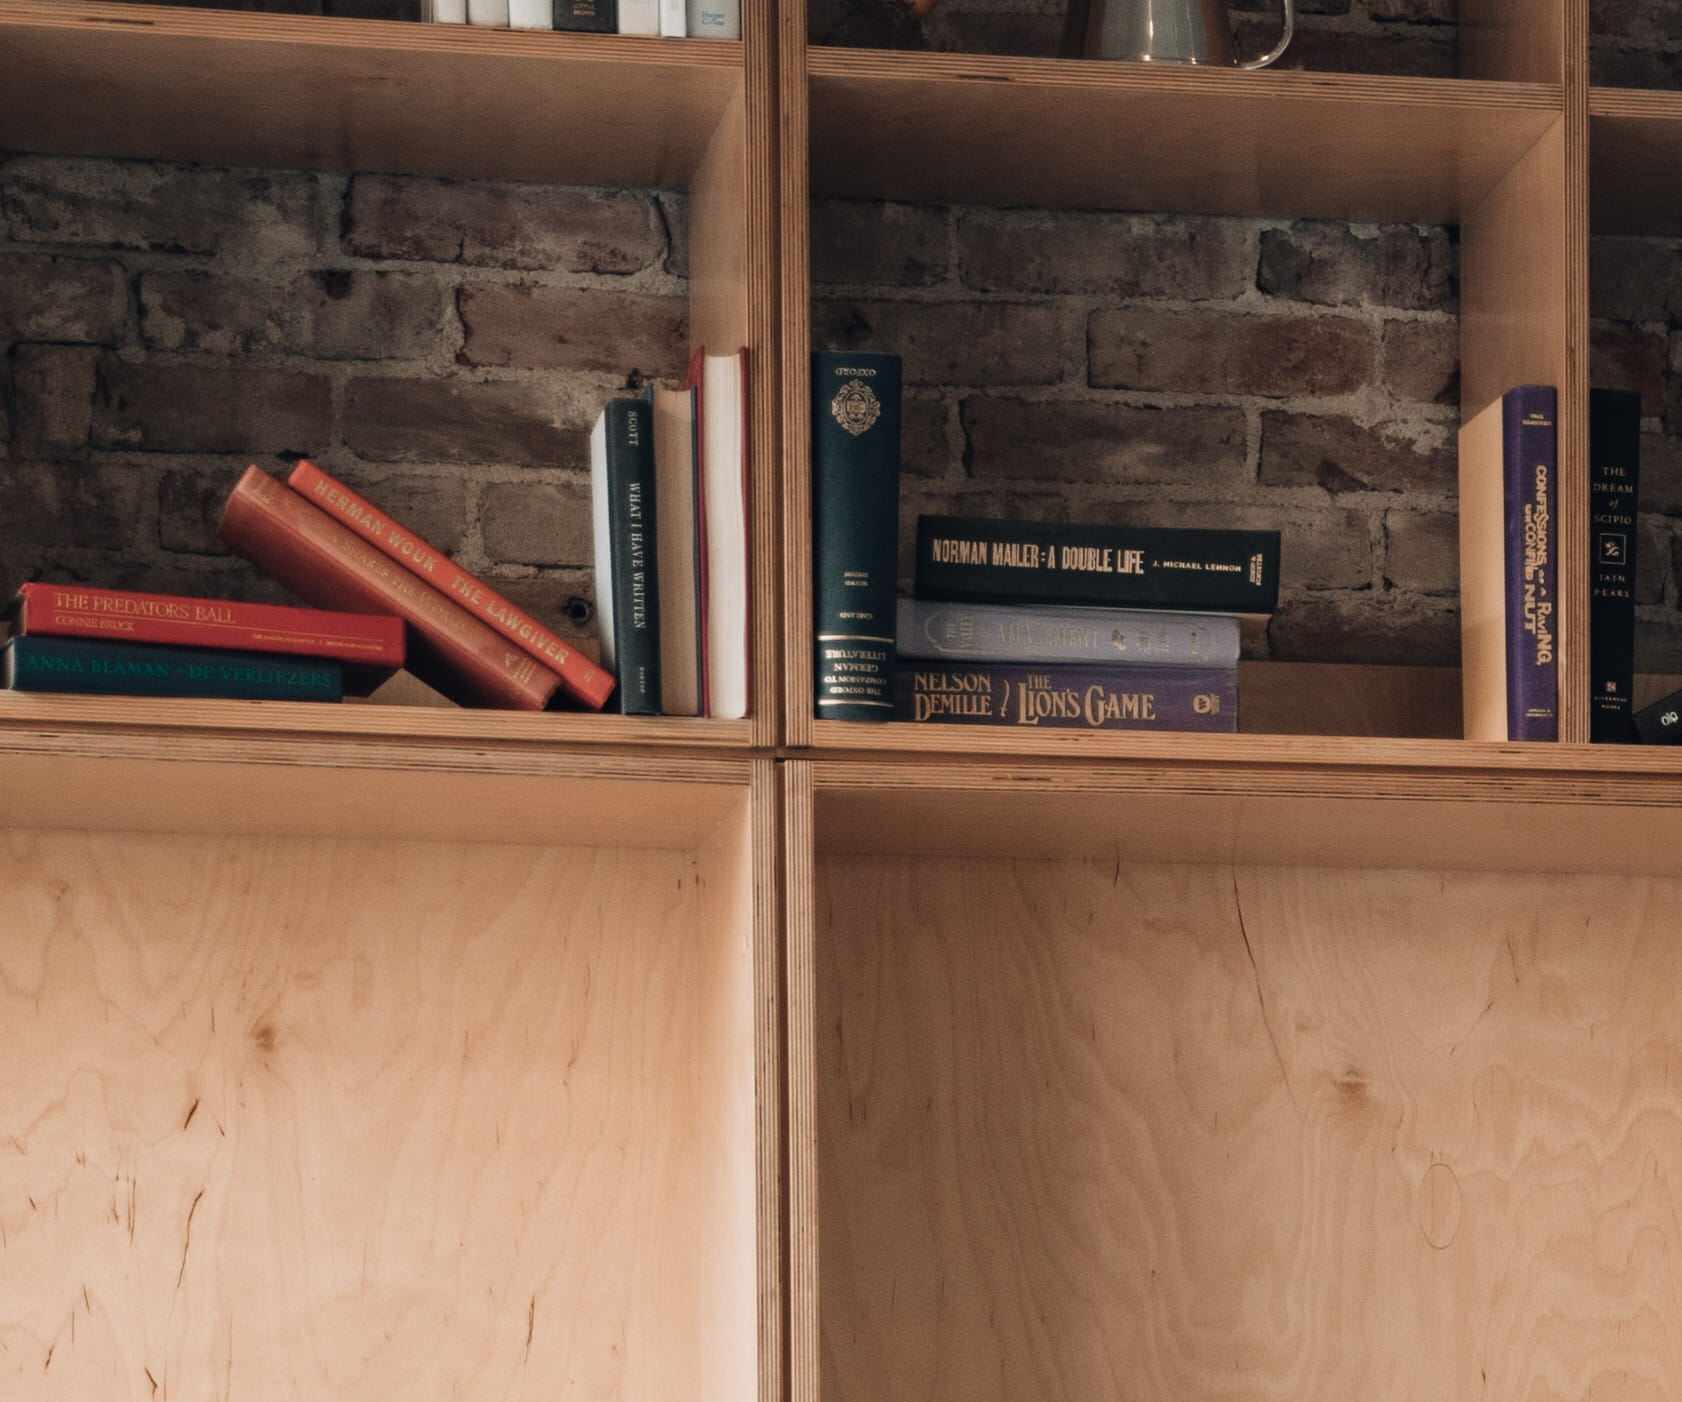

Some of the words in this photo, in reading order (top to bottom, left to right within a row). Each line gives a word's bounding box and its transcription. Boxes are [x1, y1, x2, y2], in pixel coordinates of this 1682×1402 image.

[835, 367, 877, 376] OXFORD
[628, 410, 639, 446] SCOTT
[1603, 467, 1625, 477] THE
[1593, 483, 1633, 493] DREAM
[629, 482, 642, 520] WHAT
[1609, 499, 1619, 509] of
[1534, 465, 1549, 565] CONFESSIONS
[1594, 514, 1632, 525] SCIPIO
[631, 532, 643, 568] HAVE
[932, 538, 987, 565] NORMAN
[1047, 545, 1057, 569] A
[1062, 546, 1113, 573] DOUBLE
[1117, 549, 1145, 574] LIFE
[313, 479, 385, 534] HERMAN
[387, 531, 437, 571] WOUK
[451, 576, 483, 606] THE
[486, 602, 568, 665] LAWGIVER
[1152, 560, 1161, 568] J.
[1163, 561, 1202, 570] MICHAEL
[1205, 564, 1242, 572] LENNON
[1600, 574, 1625, 582] IAIN
[633, 571, 647, 630] WRITTEN
[1594, 588, 1630, 598] PEARS
[53, 592, 90, 609] THE
[93, 595, 191, 620] PREDATORS
[195, 606, 237, 625] BALL
[1524, 584, 1536, 635] NUT
[55, 615, 99, 629] CONNIE
[99, 617, 136, 632] BRUCK
[825, 649, 886, 661] LITERATURE
[26, 655, 84, 673] ANNA
[90, 659, 169, 678] BLAMAN
[188, 664, 214, 680] DE
[218, 666, 331, 688] VERLIEZERS
[834, 662, 879, 672] GERMAN
[824, 675, 837, 683] TO
[914, 672, 992, 692] NELSON
[1027, 674, 1052, 690] THE
[830, 686, 865, 694] OXFORD
[1018, 681, 1079, 725] LION'S
[1084, 685, 1157, 727] GAME
